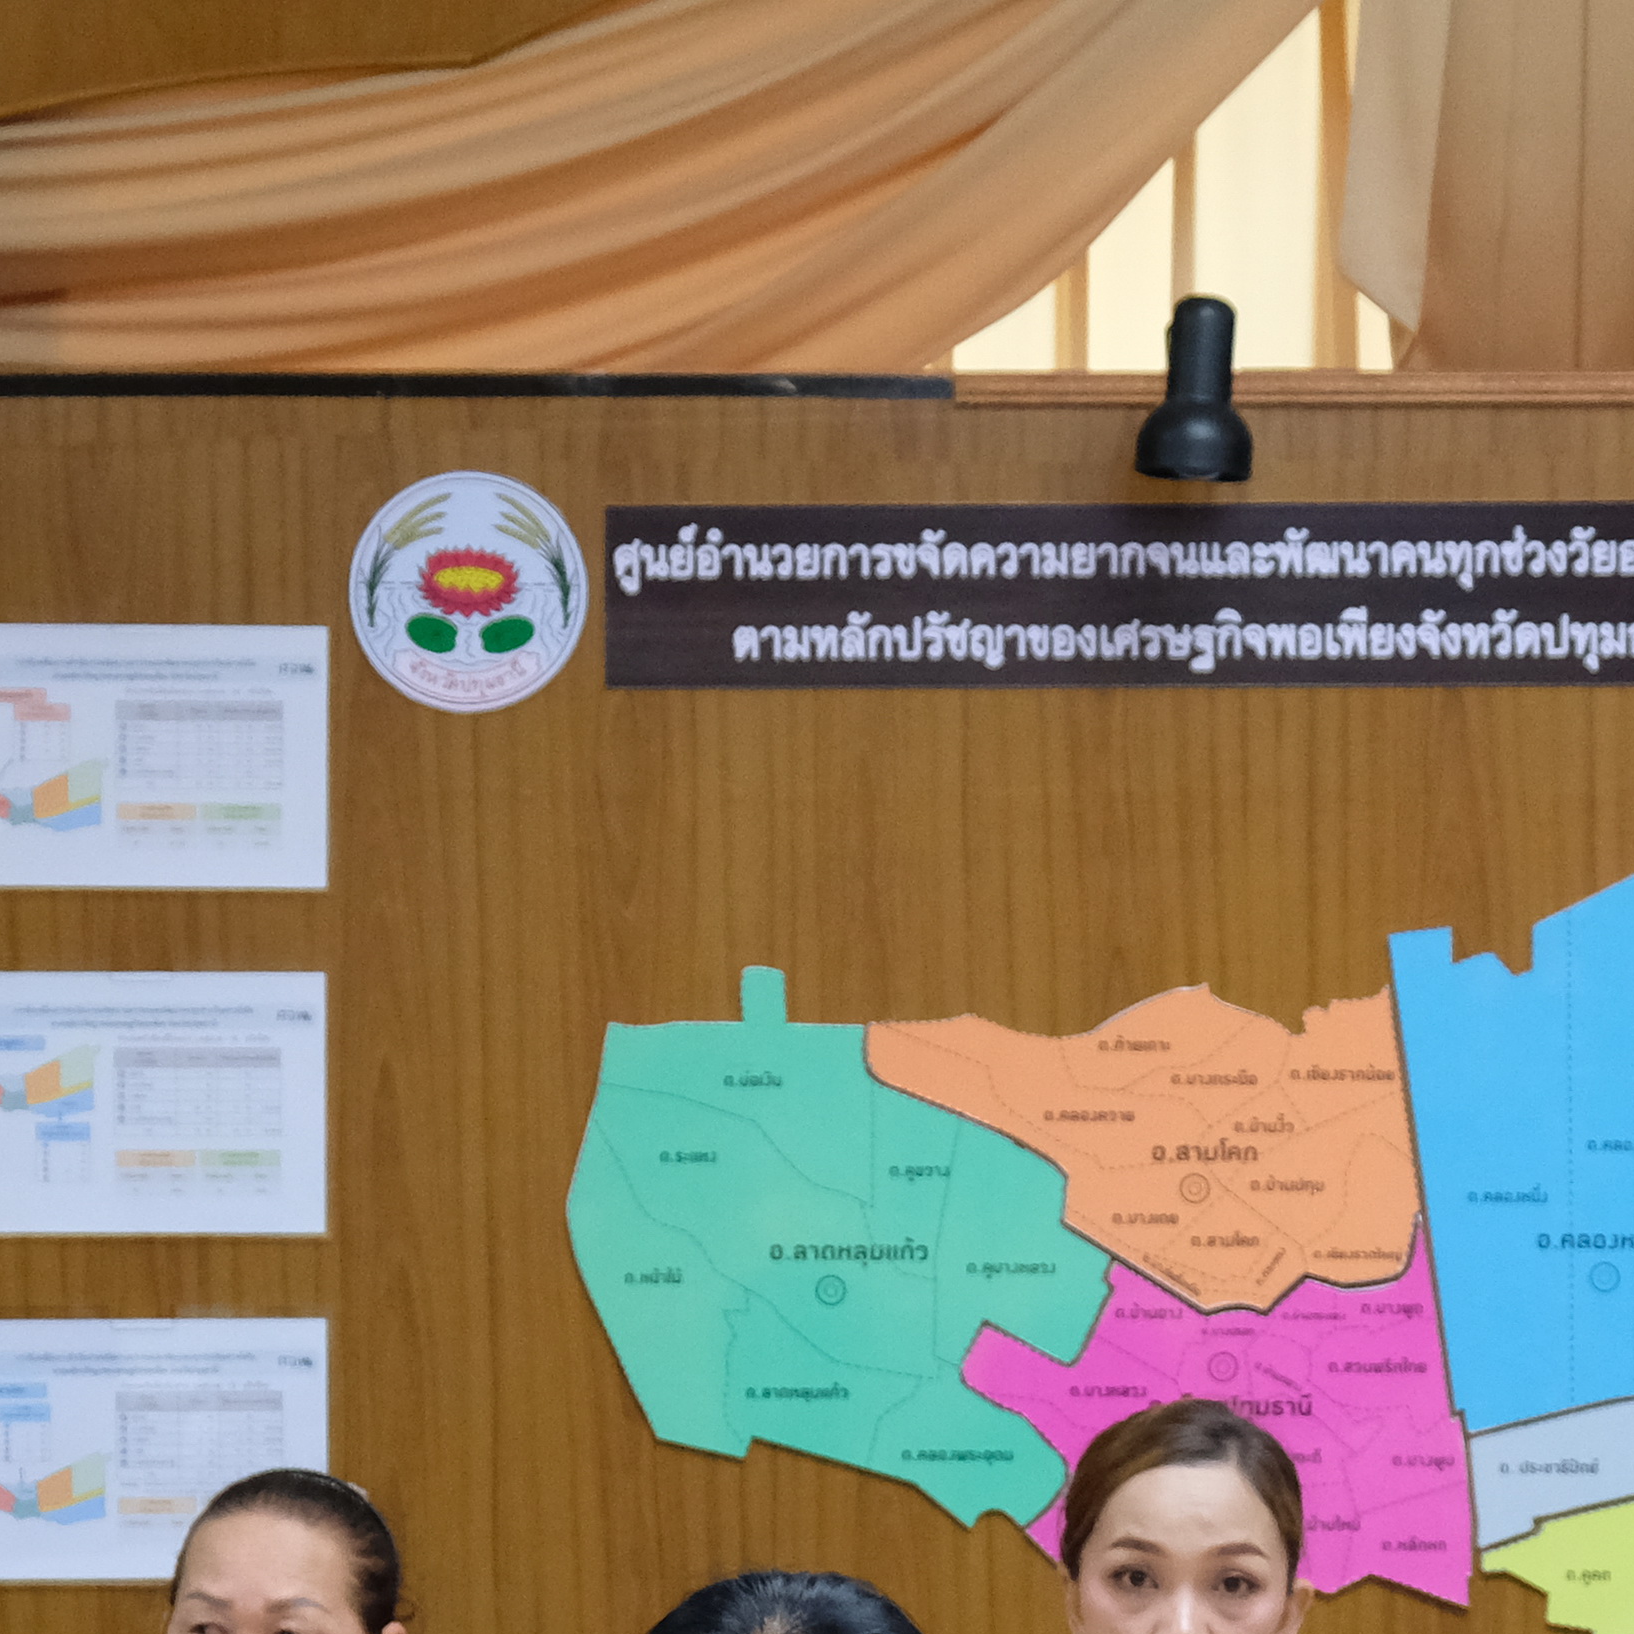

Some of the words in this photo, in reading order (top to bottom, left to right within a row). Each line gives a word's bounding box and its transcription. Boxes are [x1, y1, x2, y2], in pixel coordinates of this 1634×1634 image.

[1151, 1137, 1259, 1165] อ.สามโคก
[769, 1236, 929, 1267] อ.ลาดหลุมแก้ว
